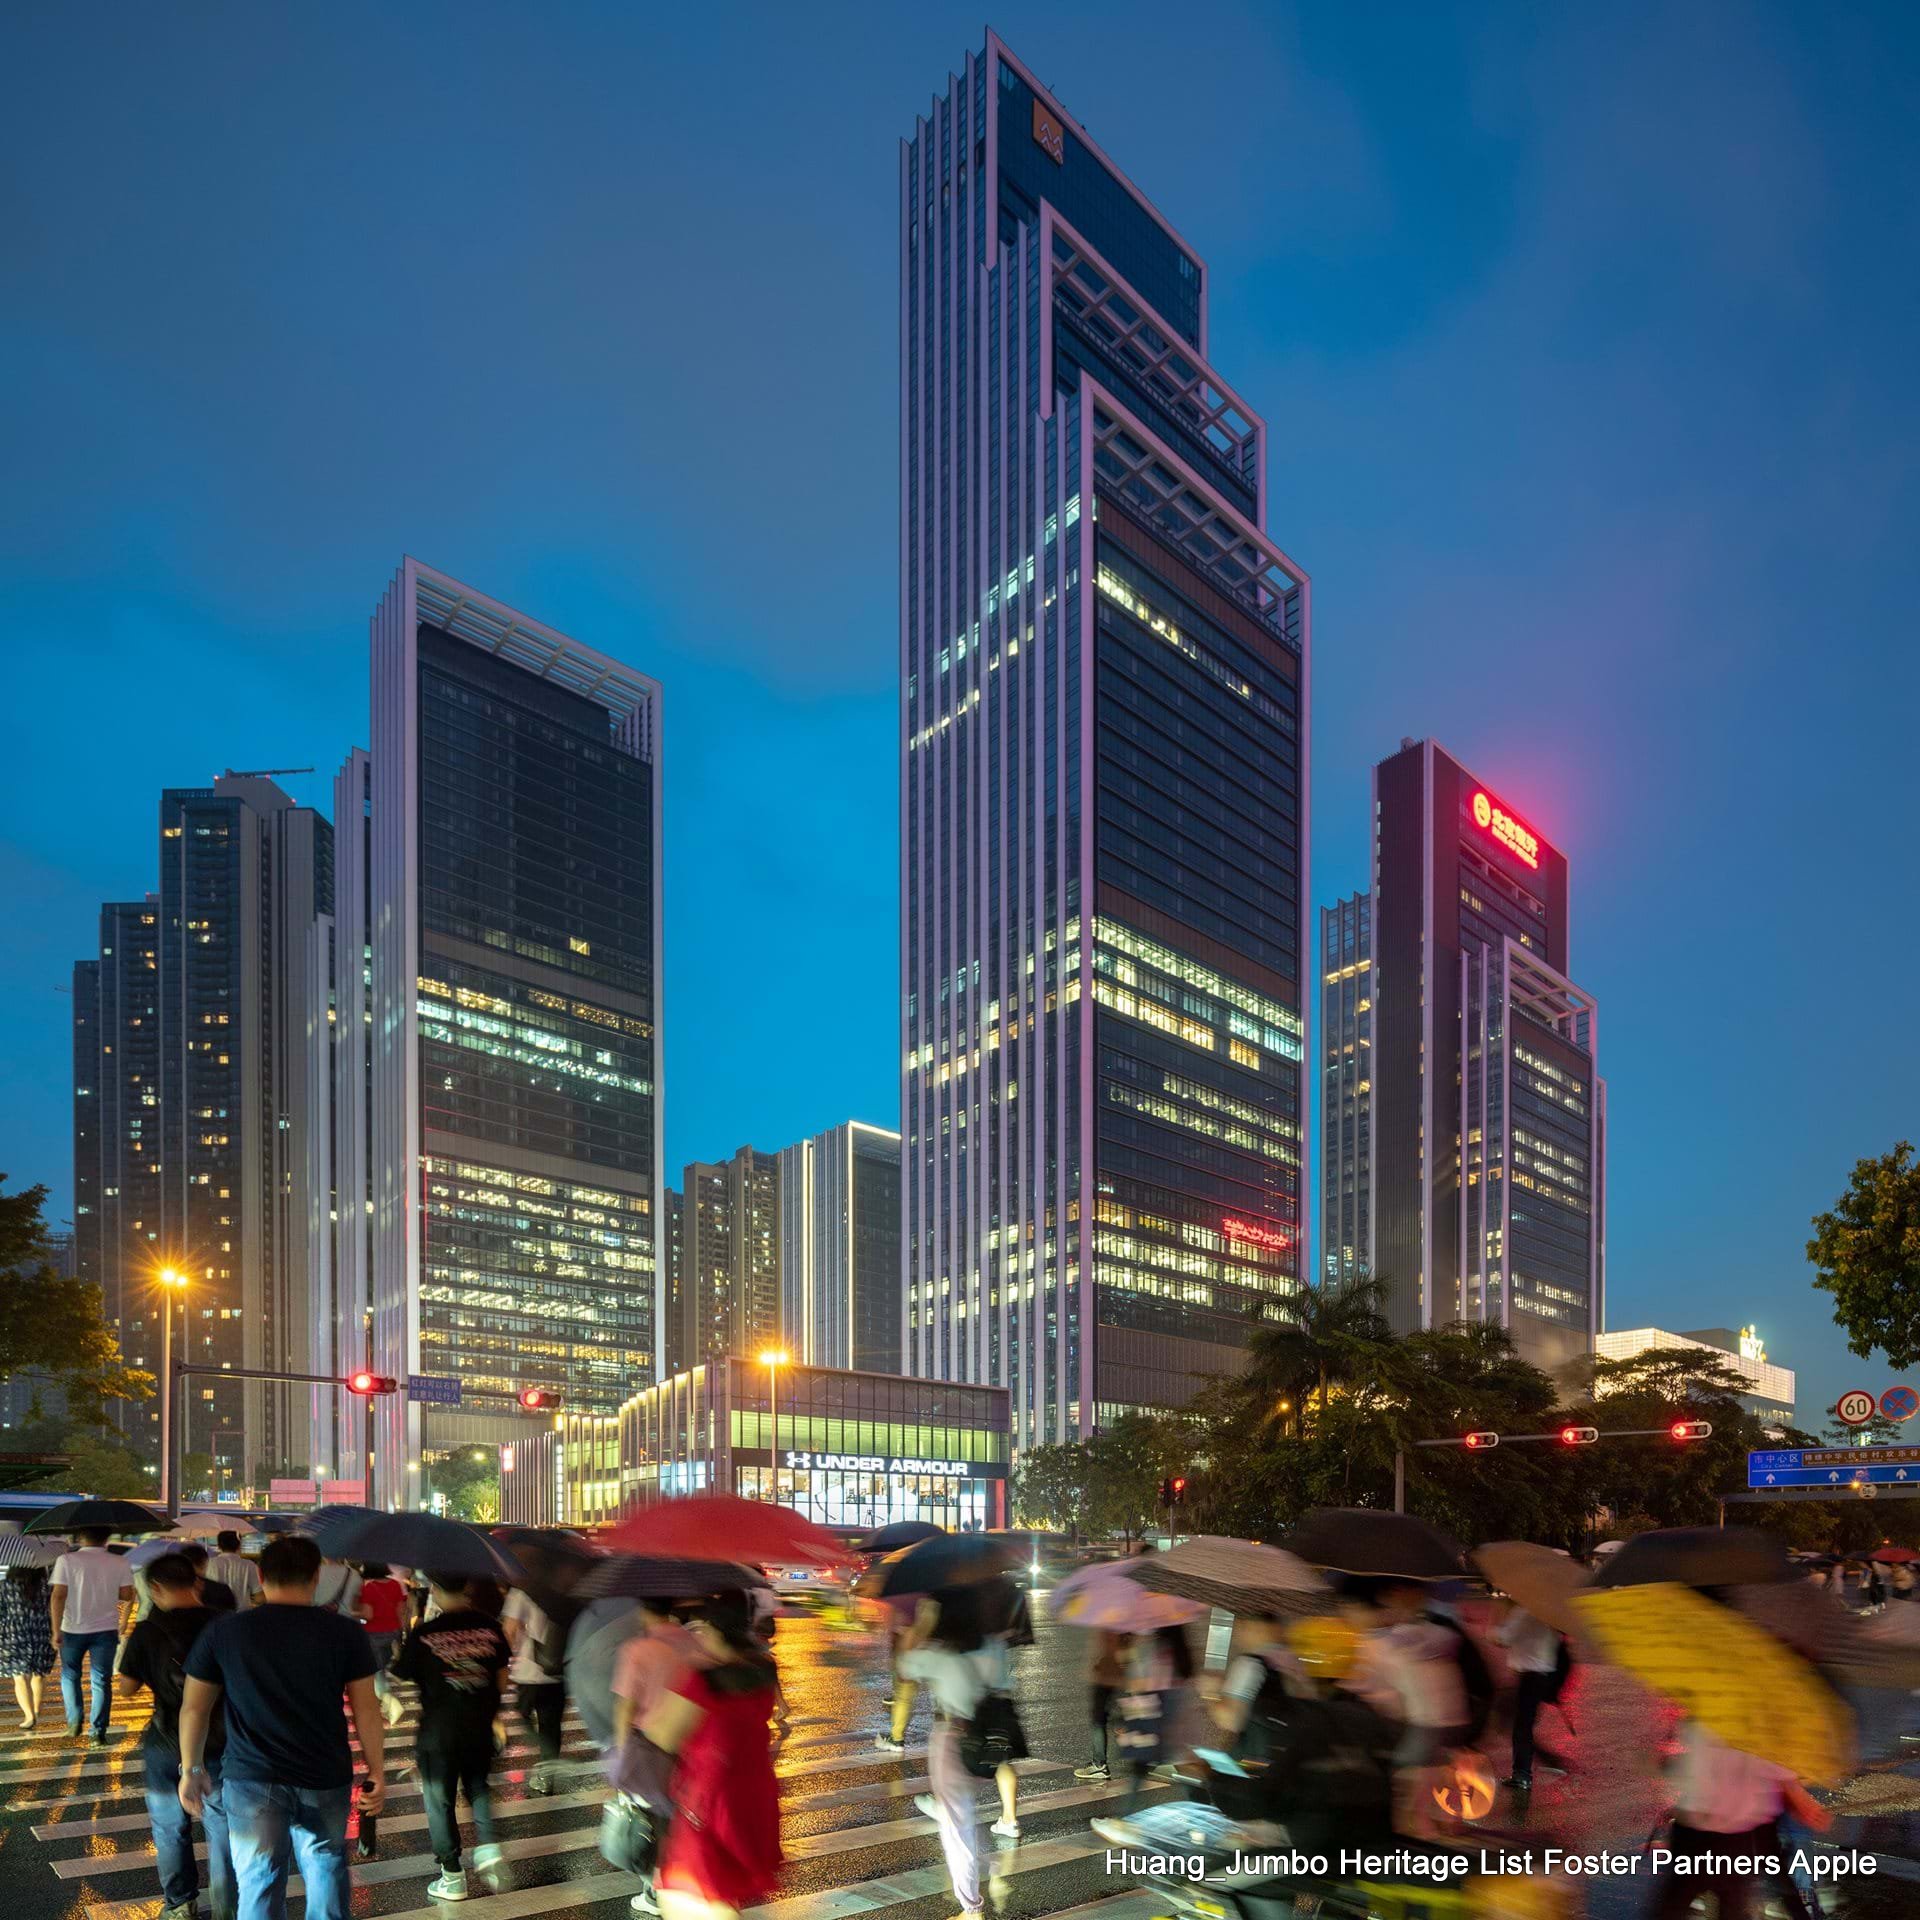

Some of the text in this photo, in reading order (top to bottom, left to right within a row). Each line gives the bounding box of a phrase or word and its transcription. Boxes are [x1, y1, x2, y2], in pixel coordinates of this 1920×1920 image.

[1845, 1398, 1868, 1416] 60
[816, 1454, 969, 1476] UNDER ARMOUR
[1753, 1453, 1799, 1464] 市中心区
